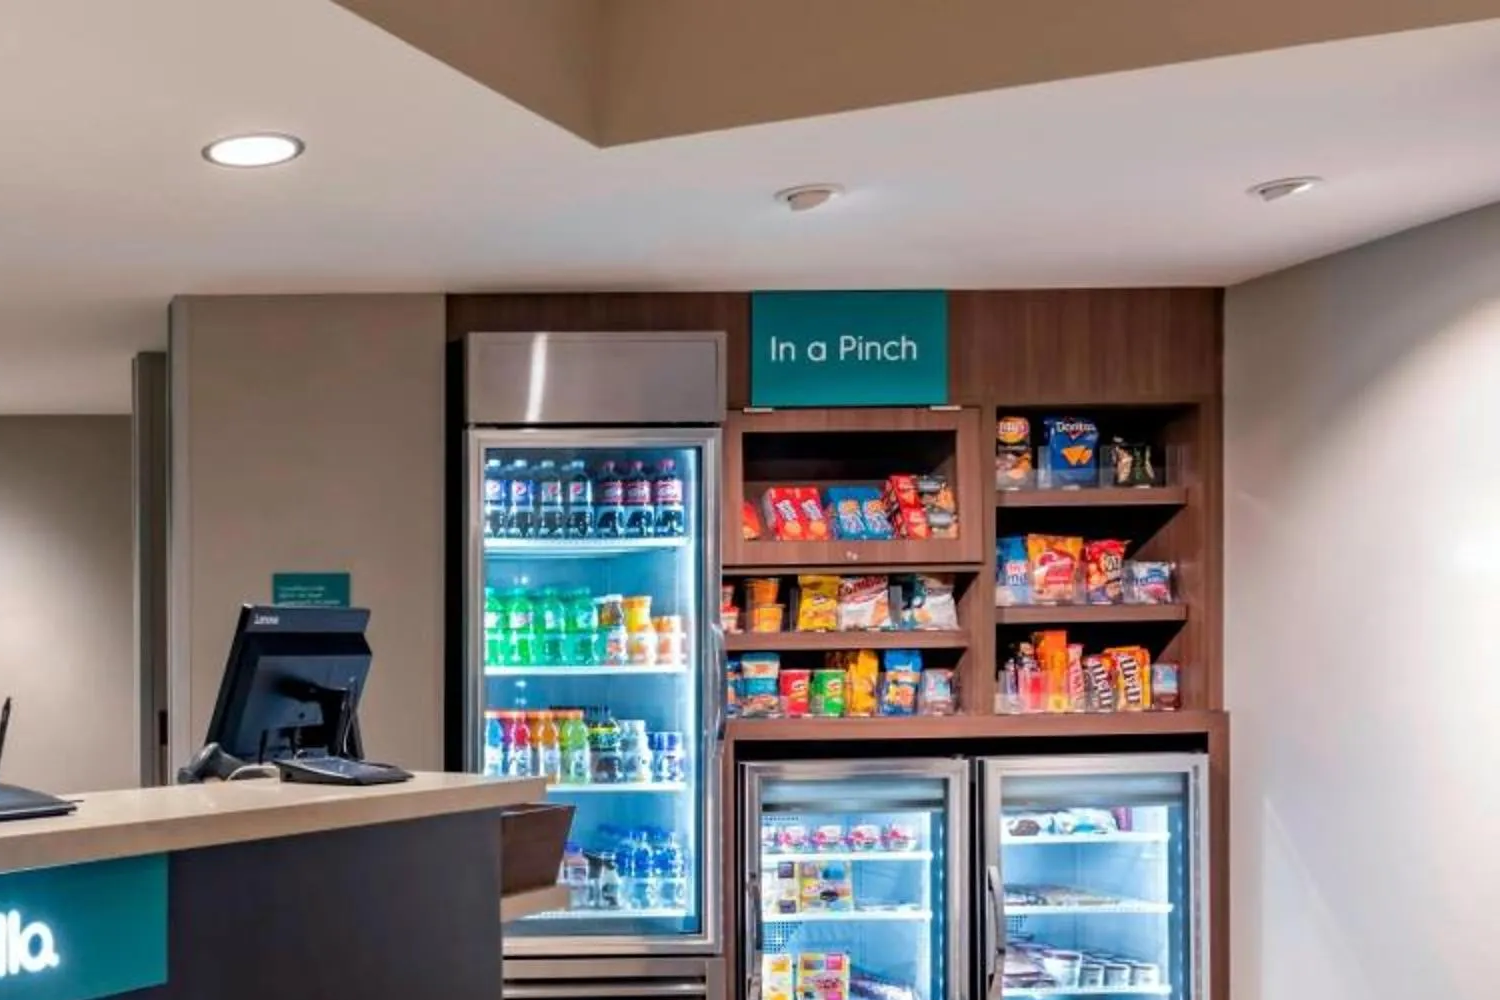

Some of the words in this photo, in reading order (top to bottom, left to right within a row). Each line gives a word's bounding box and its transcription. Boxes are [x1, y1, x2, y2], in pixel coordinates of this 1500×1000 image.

[770, 336, 796, 361] In
[807, 340, 827, 361] a
[839, 335, 918, 361] Pinch
